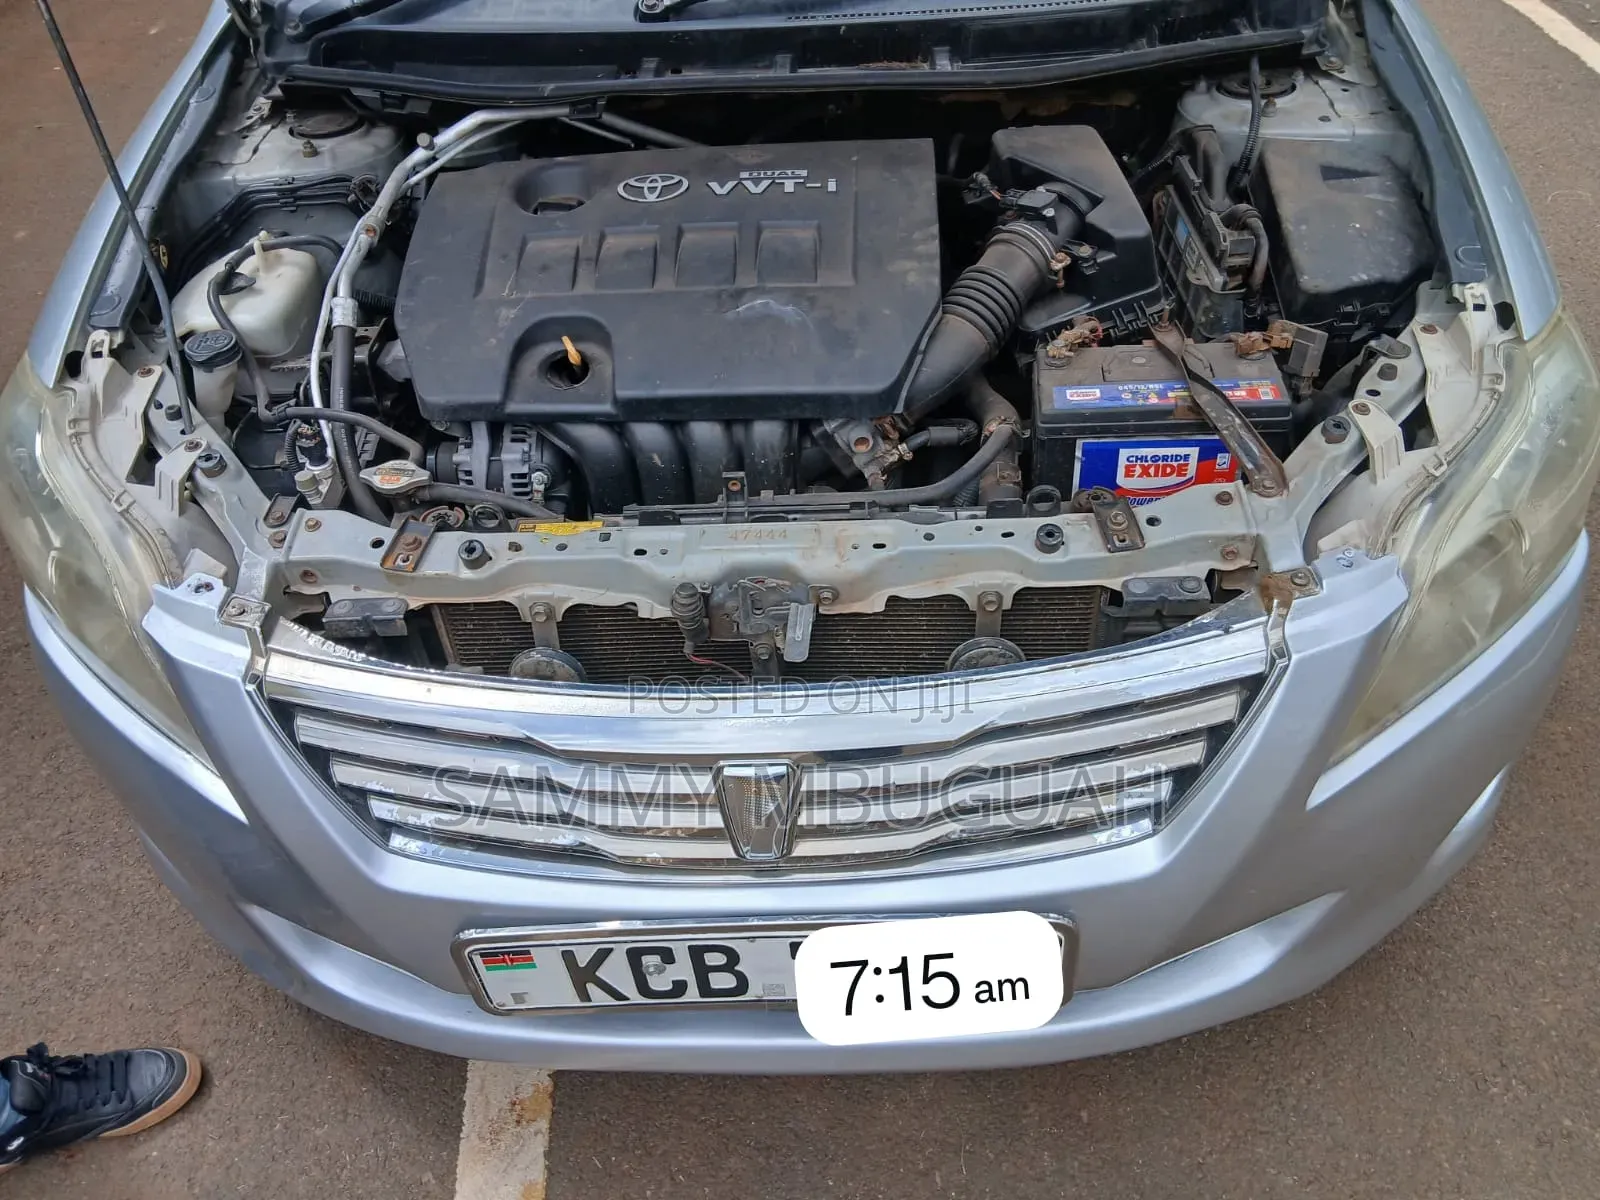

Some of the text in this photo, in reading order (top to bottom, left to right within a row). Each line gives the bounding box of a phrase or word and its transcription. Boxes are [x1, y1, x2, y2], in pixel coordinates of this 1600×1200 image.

[746, 170, 805, 178] DUAL
[707, 178, 837, 195] VVT-i
[1126, 454, 1191, 463] CHLORIDE
[1124, 463, 1190, 478] EXIDE
[561, 944, 749, 1003] KCB
